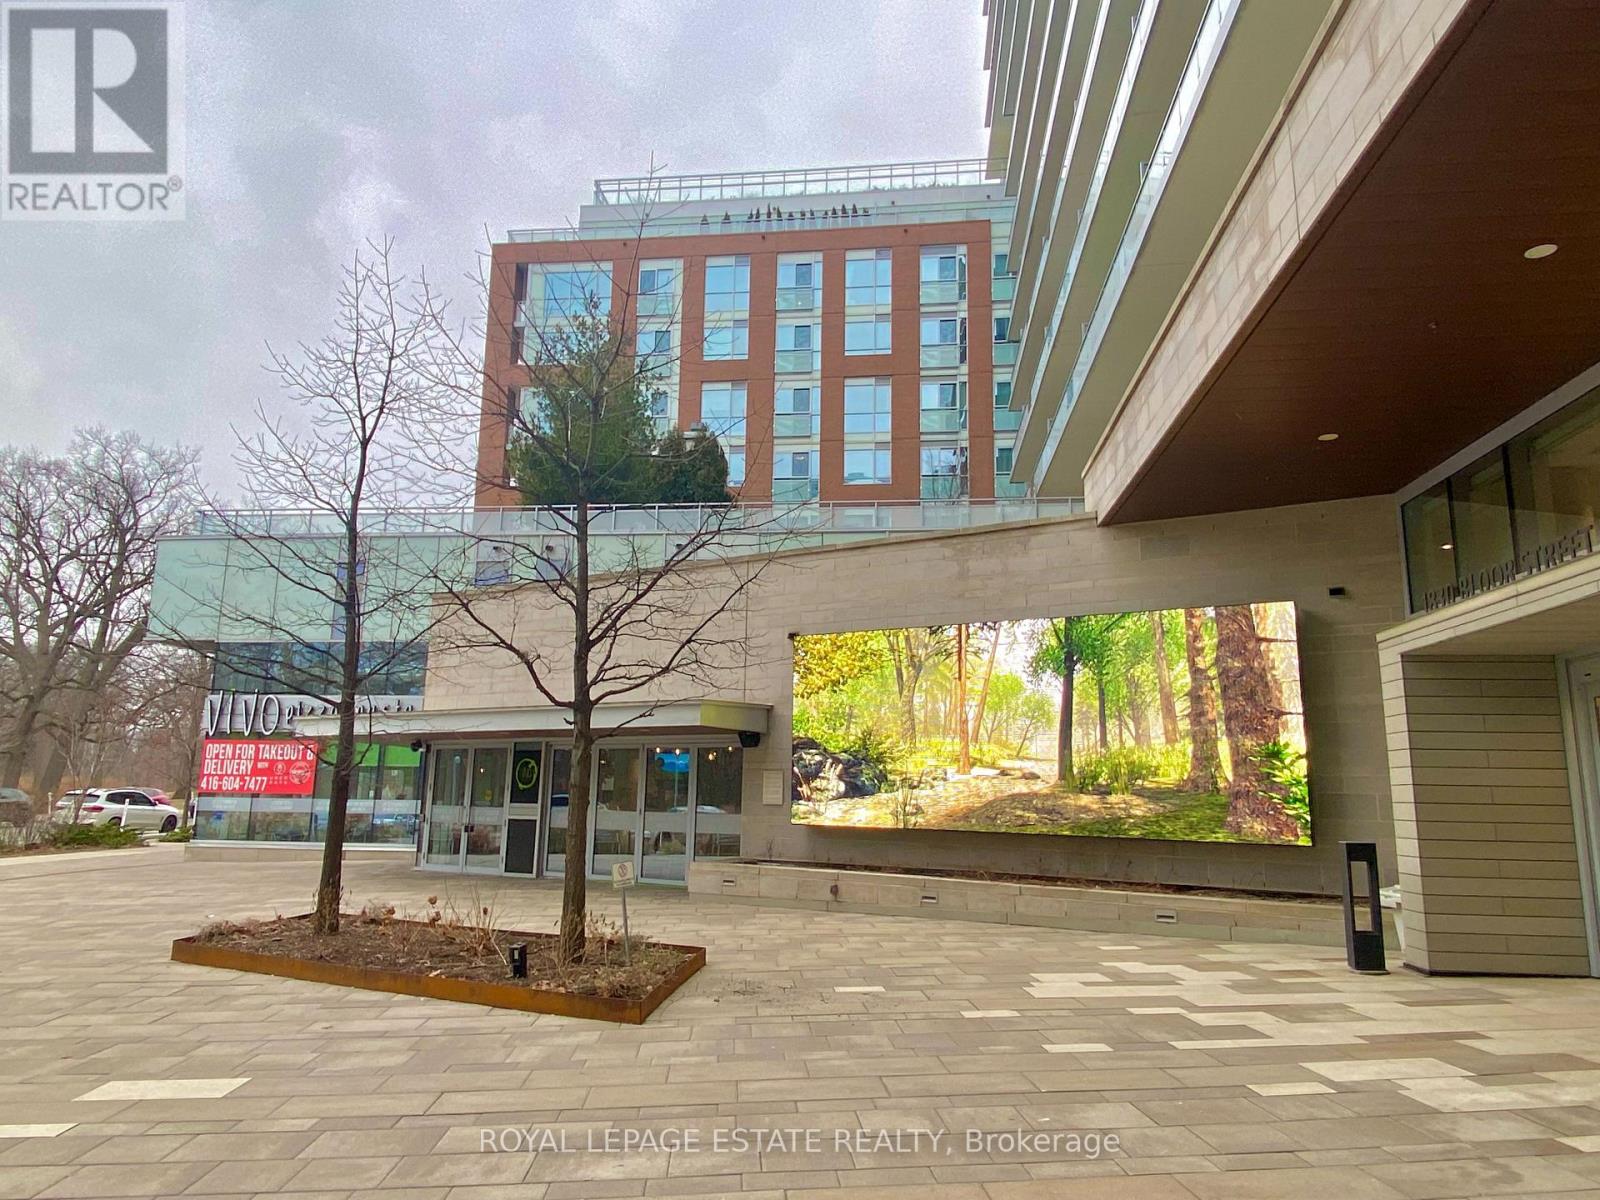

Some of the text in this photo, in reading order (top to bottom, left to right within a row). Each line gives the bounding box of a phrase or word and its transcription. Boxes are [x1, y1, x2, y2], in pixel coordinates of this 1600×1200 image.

[1458, 558, 1516, 599] BLOOR
[1521, 524, 1594, 575] STREET
[208, 688, 279, 736] VIVO
[205, 743, 233, 759] OPEN
[235, 744, 255, 760] FOR
[257, 744, 305, 760] TAKEOUT
[203, 759, 254, 775] DELIVERY
[200, 776, 268, 791] 416-604-7477
